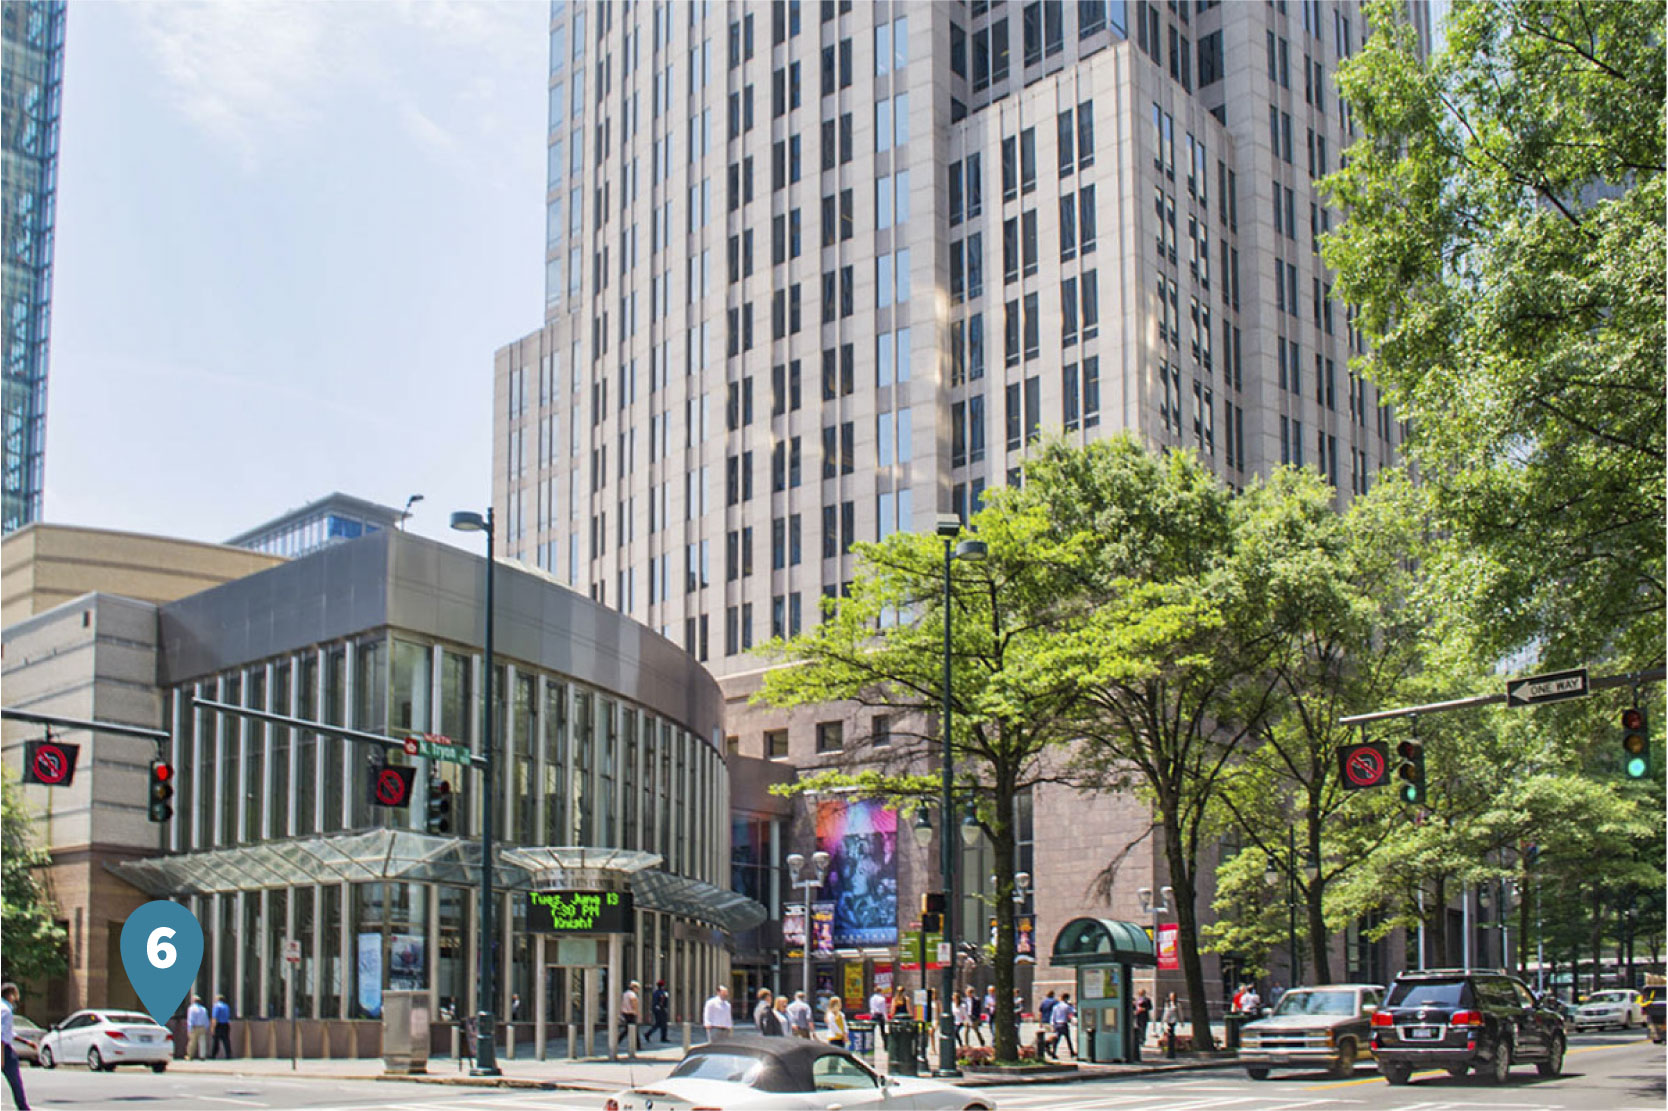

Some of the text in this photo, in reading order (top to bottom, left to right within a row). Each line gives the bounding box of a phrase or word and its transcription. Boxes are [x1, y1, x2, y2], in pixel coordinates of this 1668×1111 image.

[1530, 679, 1578, 695] ONE WAY
[431, 742, 456, 760] Tryon
[570, 892, 601, 905] June
[606, 892, 620, 906] 13
[581, 904, 600, 917] PM
[553, 916, 593, 929] Knight
